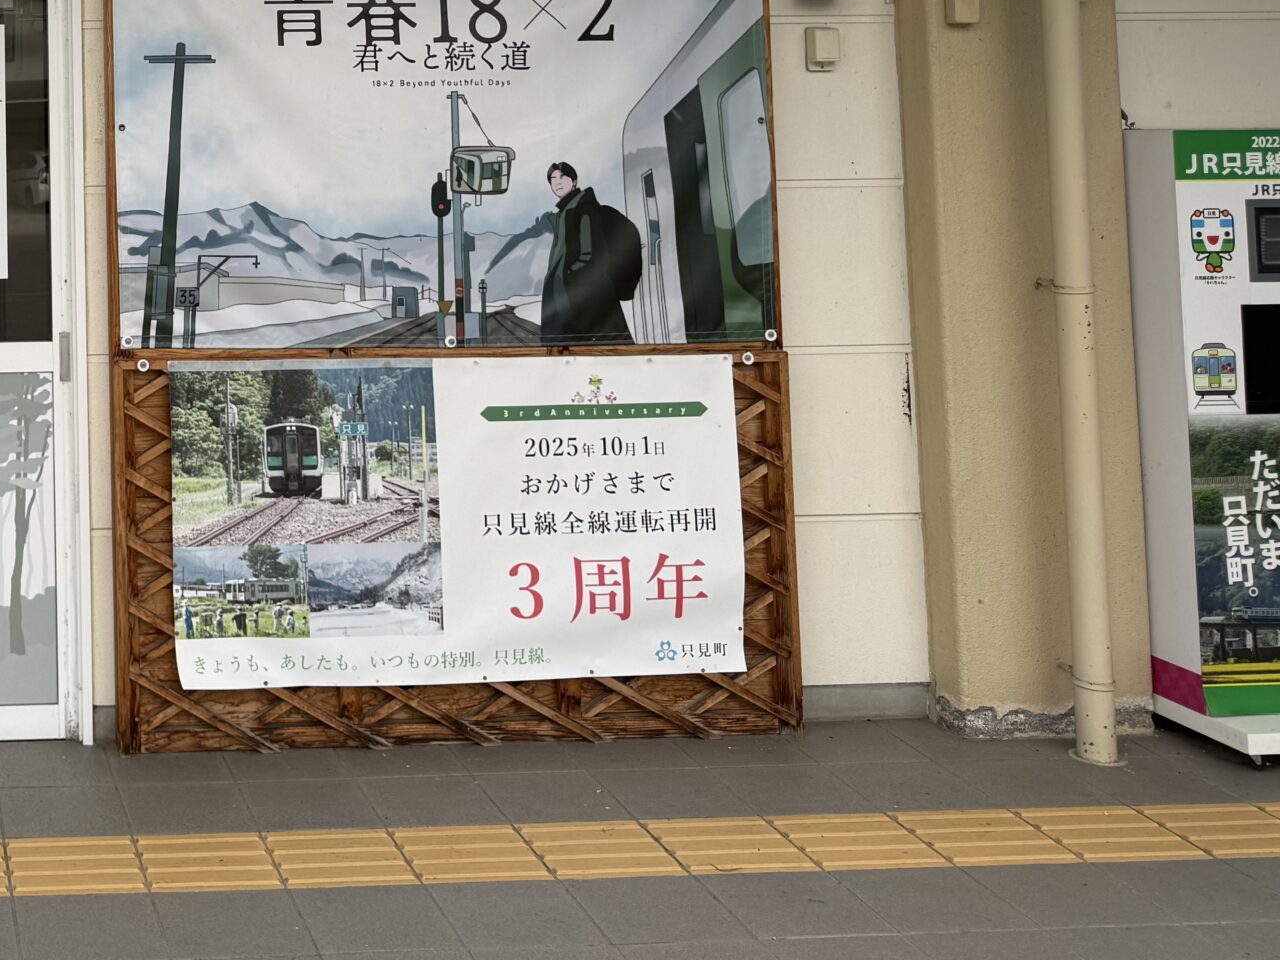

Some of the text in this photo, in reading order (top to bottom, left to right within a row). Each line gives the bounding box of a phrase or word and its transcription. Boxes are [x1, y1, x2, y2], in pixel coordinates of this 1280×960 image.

[352, 41, 532, 72] 君へと続く道
[399, 78, 436, 88] Beyond
[440, 77, 484, 88] Youthful
[488, 78, 512, 88] Days
[179, 289, 197, 305] 35
[341, 423, 367, 435] 只見
[524, 435, 666, 458] 2025年10月1日
[520, 471, 675, 496] おかげさまで
[481, 507, 718, 537] 只見線全線運転再開
[508, 552, 709, 624] 3周年
[680, 642, 728, 659] 只見町
